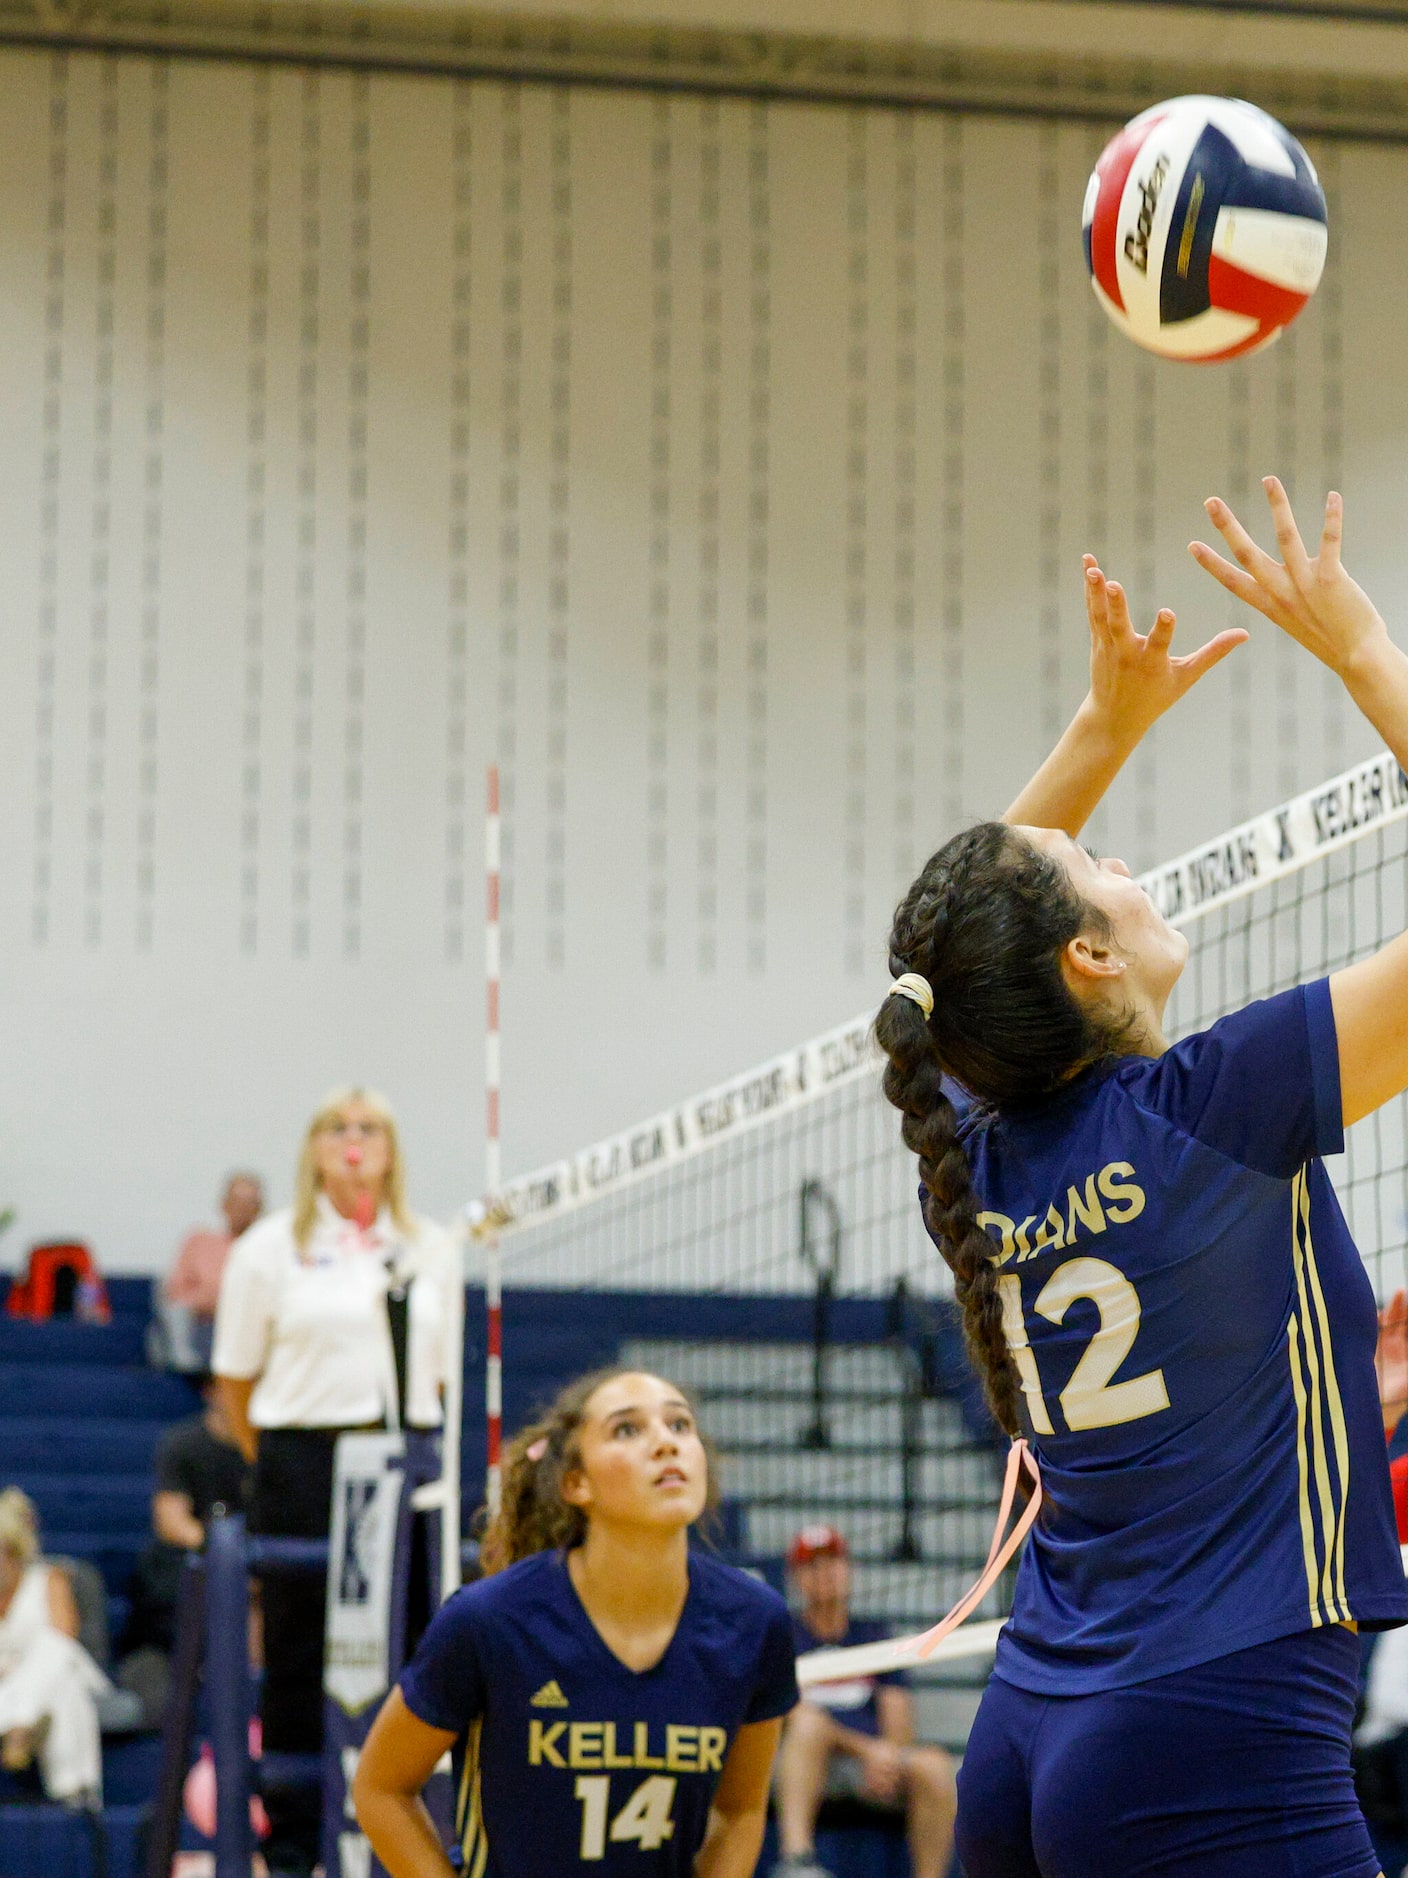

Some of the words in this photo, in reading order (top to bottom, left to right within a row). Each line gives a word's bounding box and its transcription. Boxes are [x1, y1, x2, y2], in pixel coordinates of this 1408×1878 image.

[976, 1160, 1147, 1268] DIANS
[994, 1256, 1171, 1435] 12
[528, 1719, 728, 1774] KELLER
[574, 1774, 679, 1862] 14
